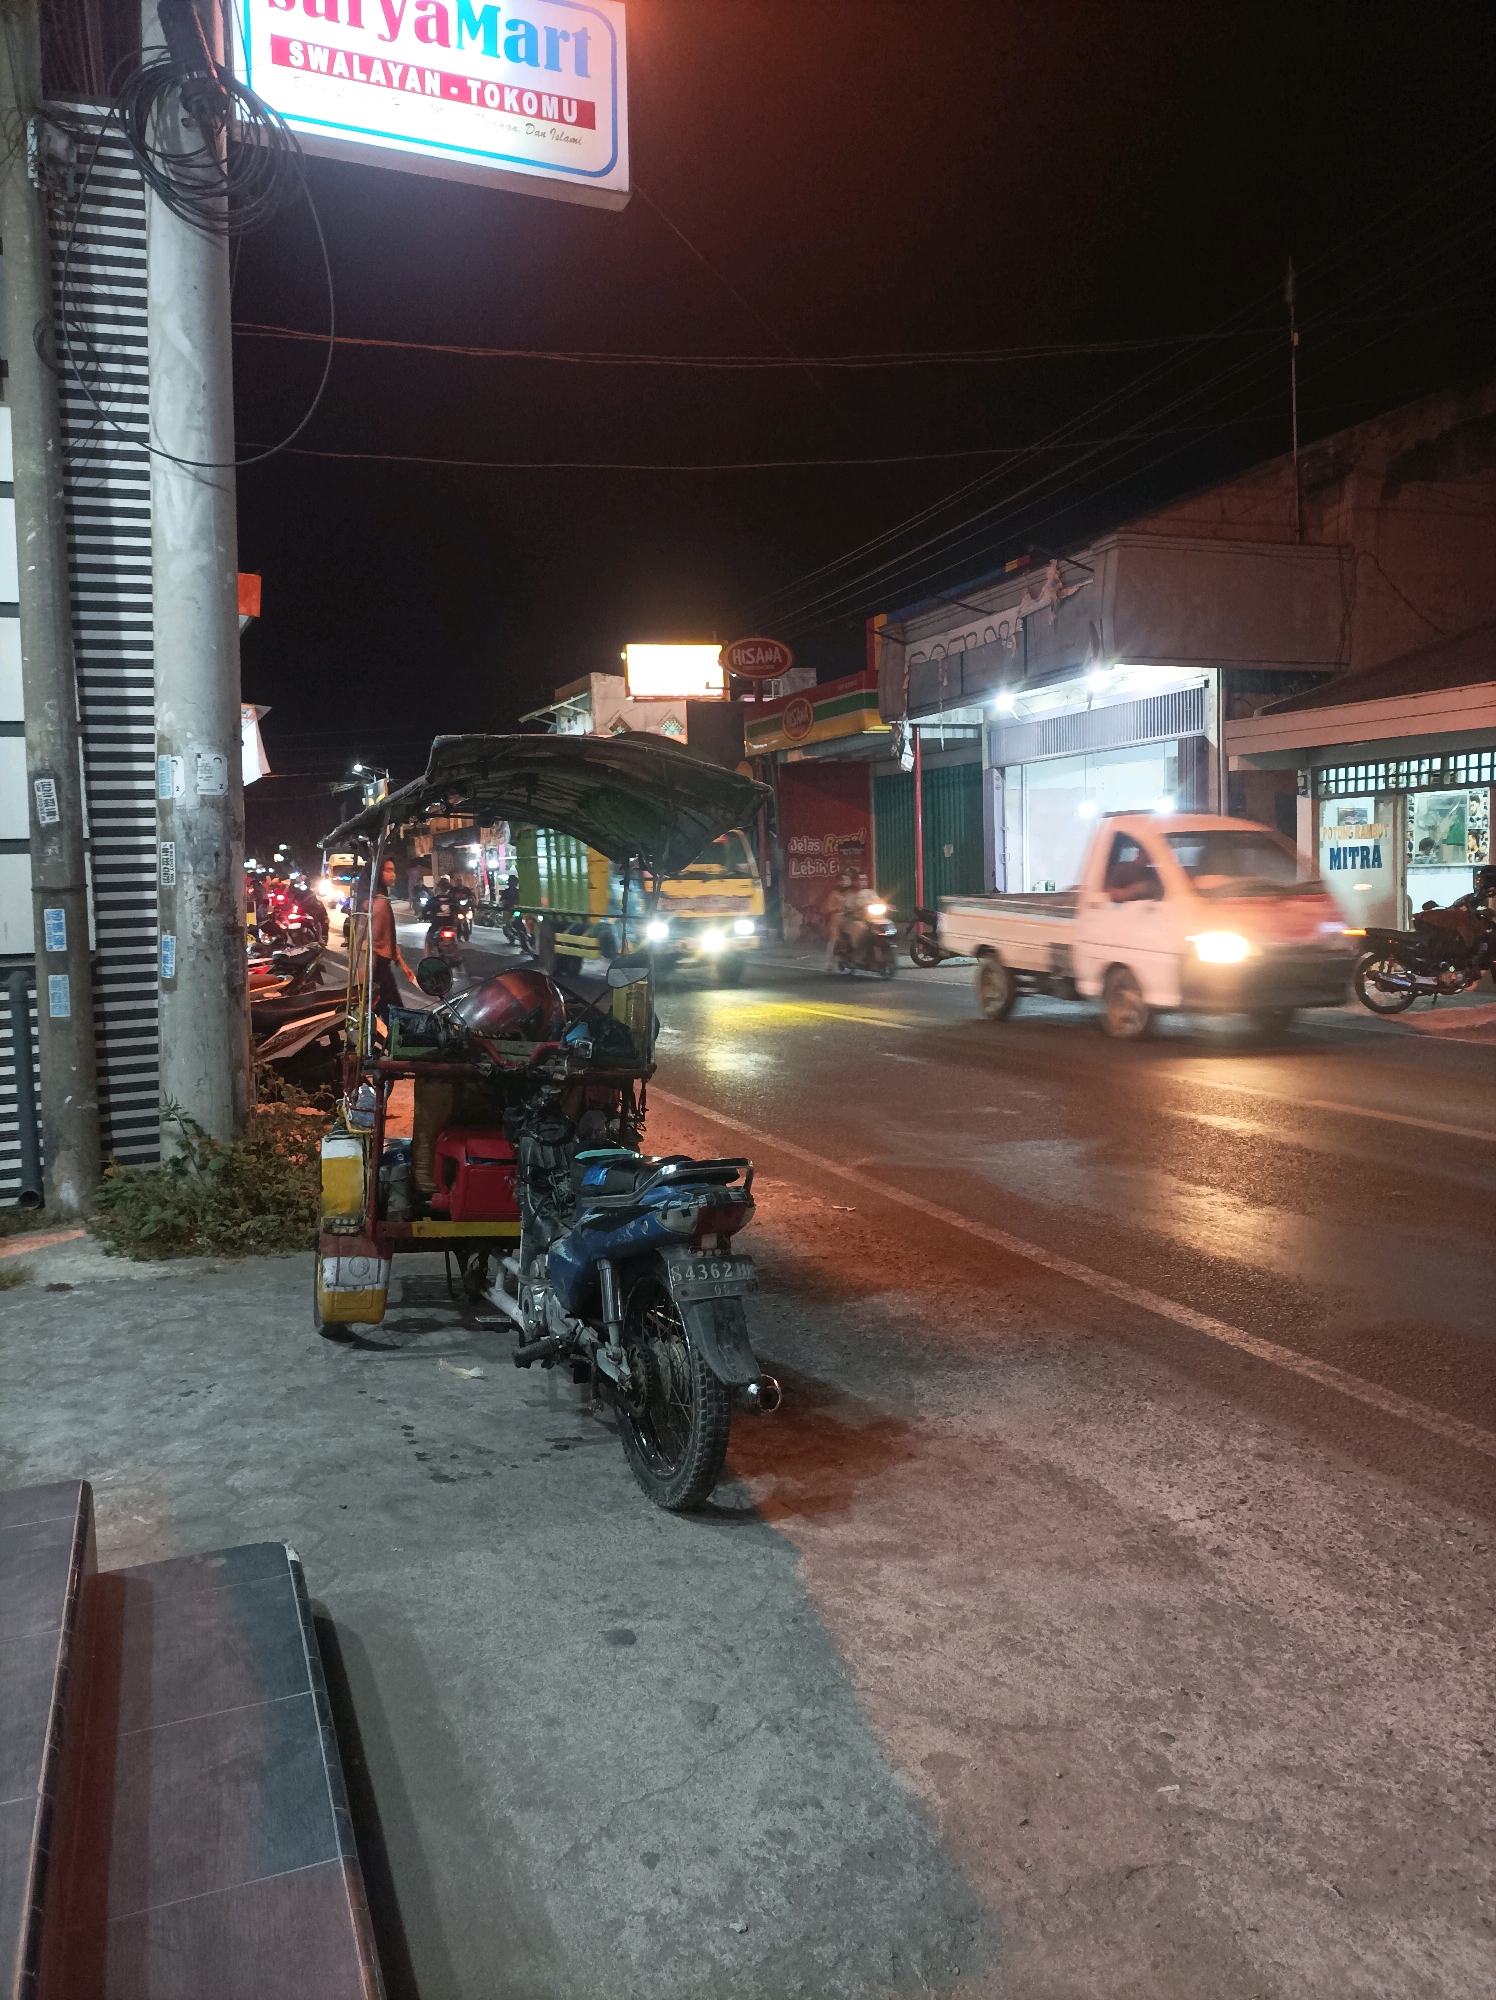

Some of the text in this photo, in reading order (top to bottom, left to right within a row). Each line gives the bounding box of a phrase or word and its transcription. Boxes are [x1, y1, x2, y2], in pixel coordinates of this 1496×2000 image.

[288, 40, 442, 97] SWALAYAN
[466, 78, 579, 123] TOKOMU
[525, 122, 547, 138] Dan
[549, 127, 582, 145] Islami
[732, 646, 783, 666] HISANA
[789, 836, 822, 853] Jelas
[790, 858, 828, 877] Lebih
[1329, 844, 1383, 871] MITRA
[685, 1261, 733, 1281] 4362
